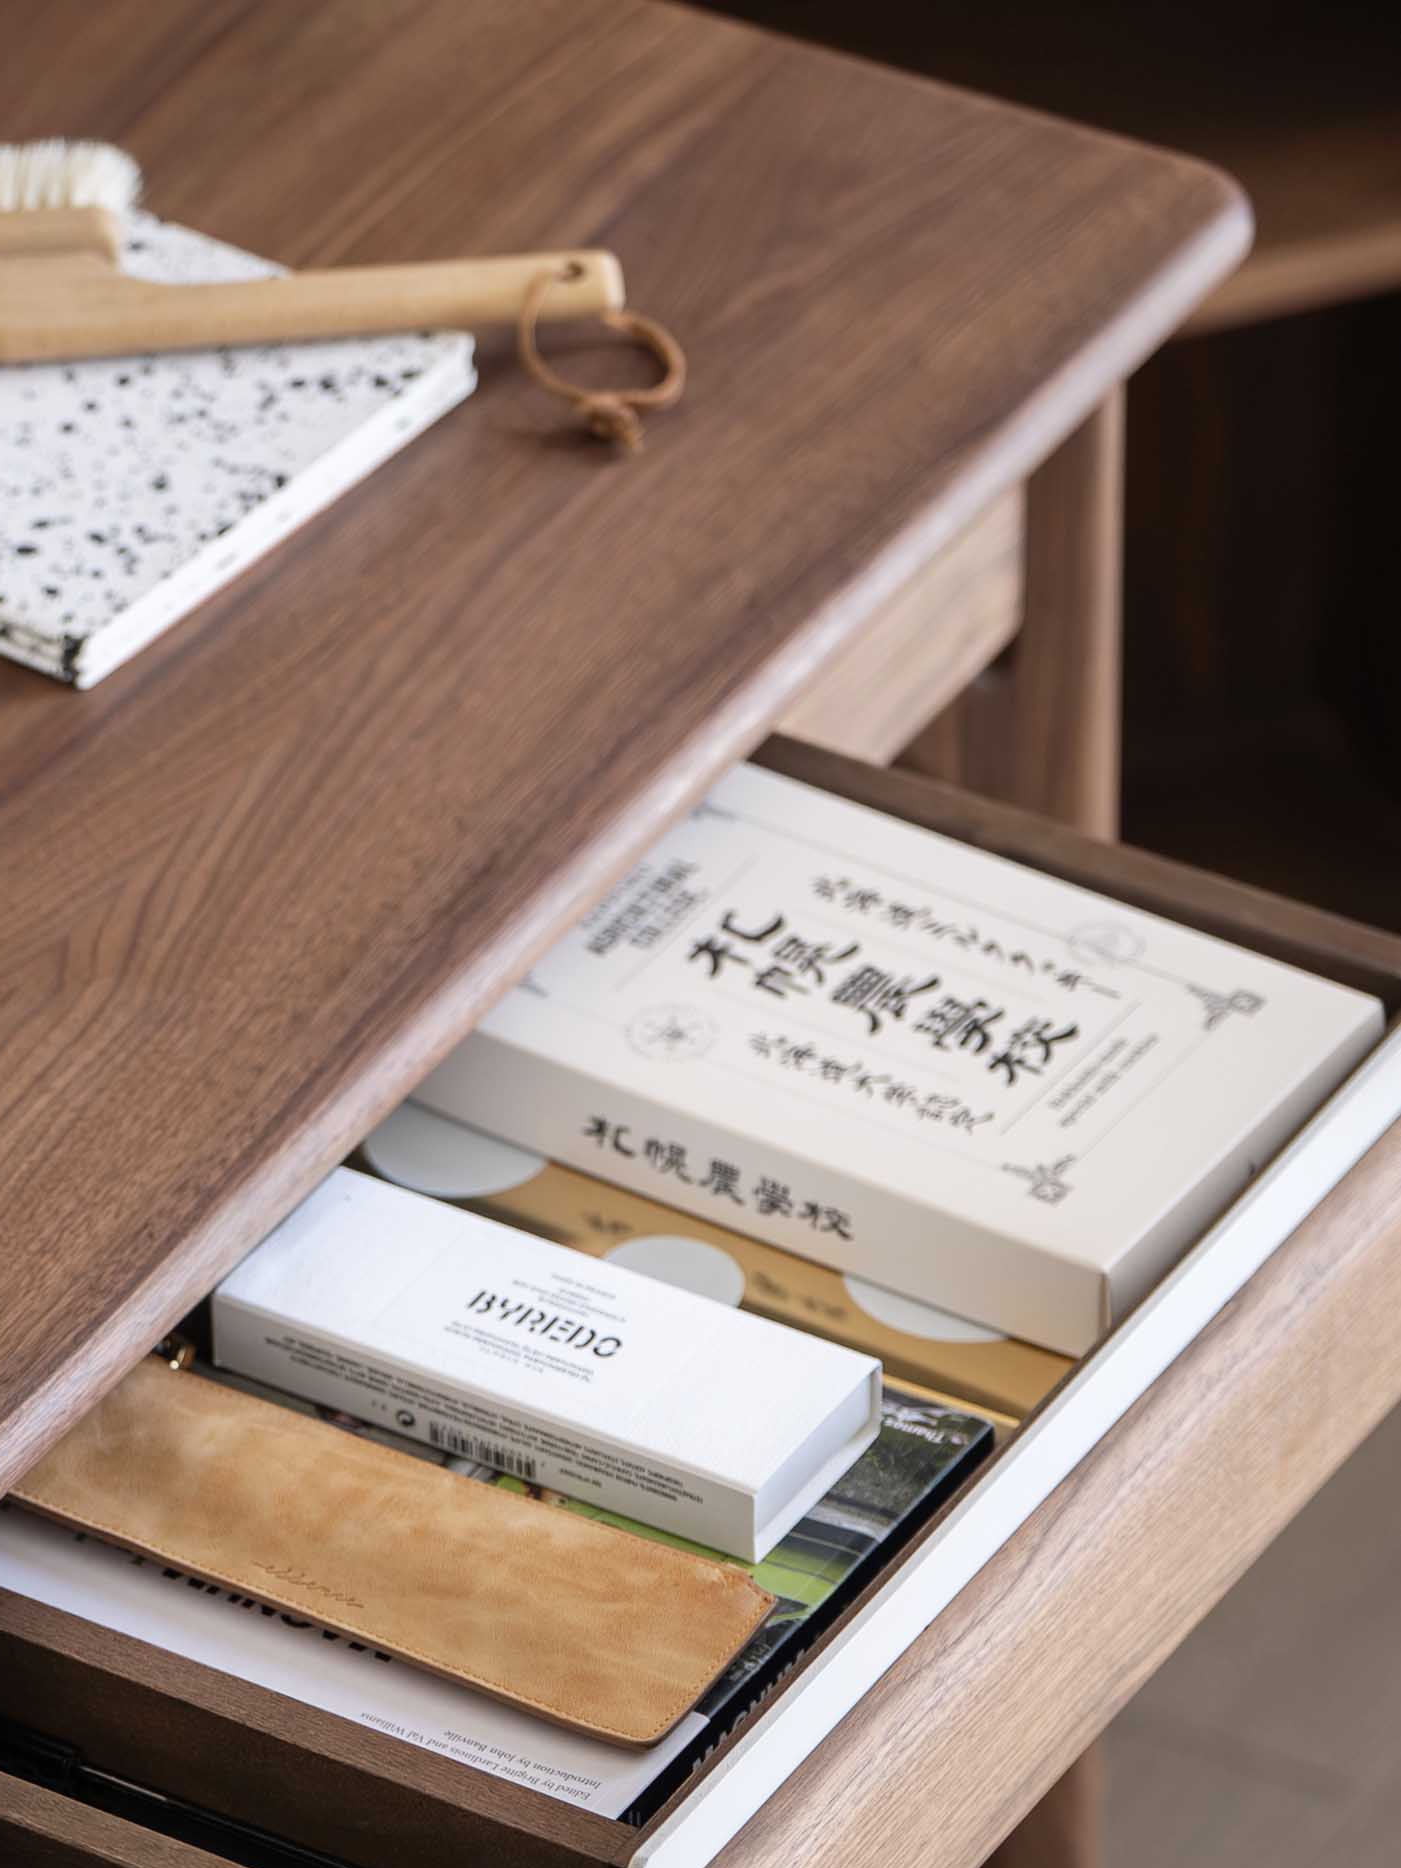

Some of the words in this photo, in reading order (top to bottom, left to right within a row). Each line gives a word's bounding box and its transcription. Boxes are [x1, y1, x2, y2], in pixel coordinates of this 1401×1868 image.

[583, 1116, 853, 1241] 札幌農學校
[467, 1290, 622, 1357] BYREDO
[532, 1763, 602, 1789] Introduction
[554, 1785, 591, 1801] Edited
